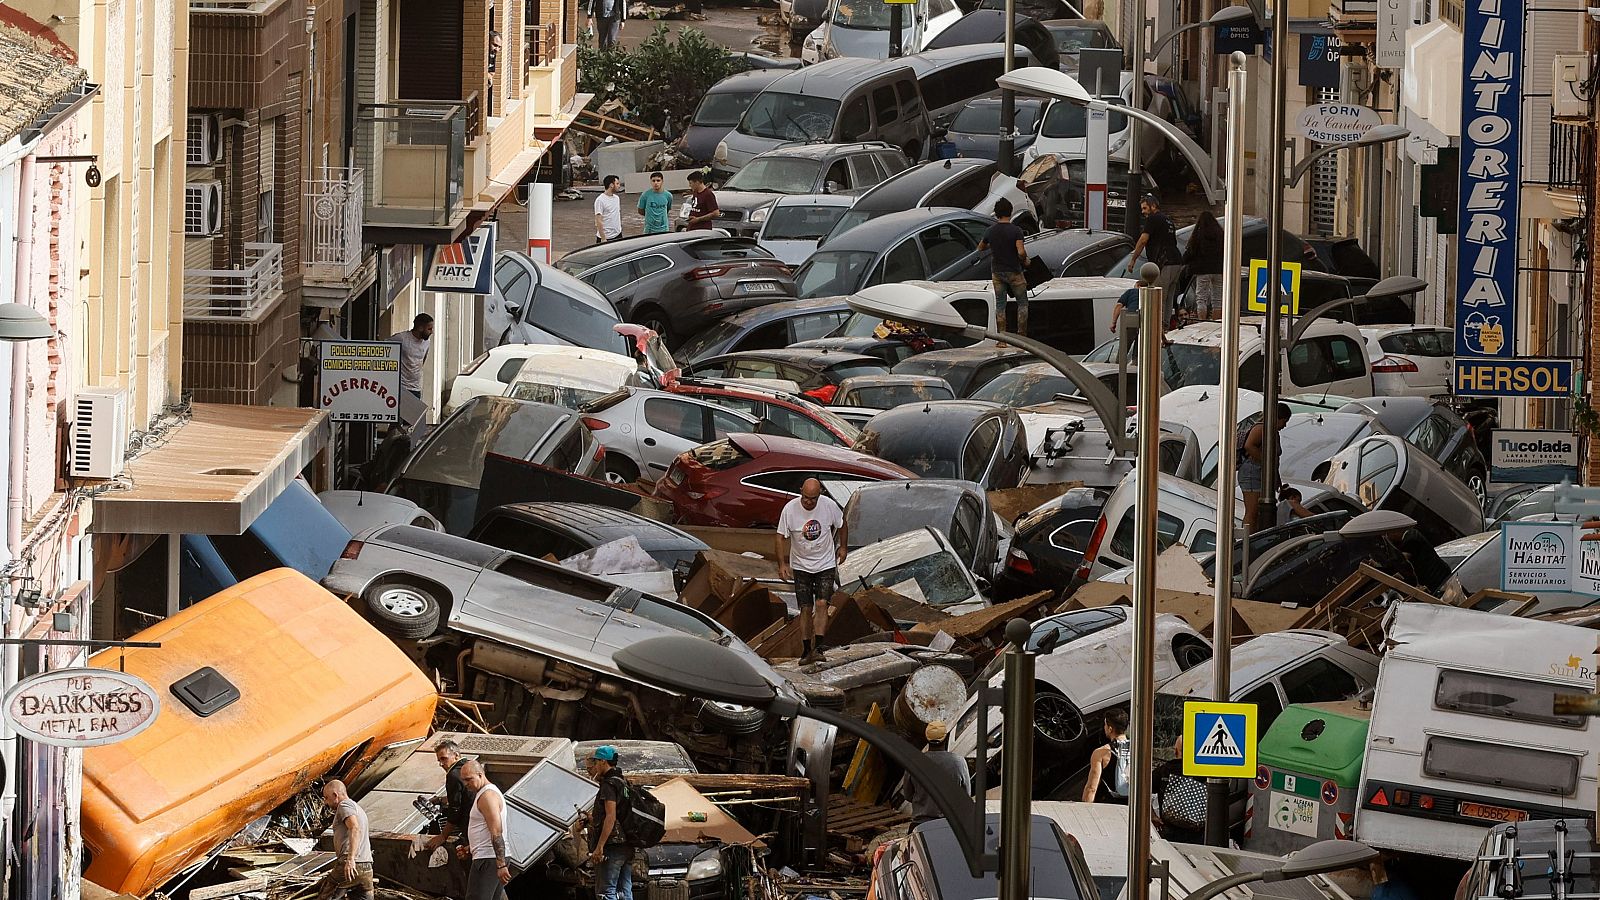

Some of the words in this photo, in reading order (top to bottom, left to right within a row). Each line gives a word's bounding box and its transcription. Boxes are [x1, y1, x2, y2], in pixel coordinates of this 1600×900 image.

[1320, 106, 1360, 117] FORN
[1304, 115, 1319, 128] La
[1323, 116, 1373, 131] Carretera
[1308, 129, 1366, 142] PASTISSERI
[435, 265, 473, 277] FIATC
[331, 345, 356, 356] POLLOS
[357, 345, 384, 358] ASADOS
[384, 346, 391, 358] Y
[323, 359, 352, 370] COMIDAS
[353, 360, 371, 371] PARA
[372, 360, 398, 371] LLEVAR
[1458, 366, 1568, 392] HERSOL
[322, 378, 397, 408] GUERRERO
[1498, 439, 1572, 453] Tucolada
[1509, 537, 1542, 551] INMO
[1513, 551, 1567, 565] HÁBITAT
[1548, 663, 1575, 677] Sun
[66, 678, 93, 692] PUB
[19, 692, 142, 716] DARKNESS
[40, 718, 85, 733] METAL
[90, 718, 119, 732] BAR
[1293, 798, 1314, 808] ALFAFAR
[1299, 814, 1313, 824] TOTS
[1462, 803, 1469, 815] Z
[1477, 807, 1511, 821] 05662
